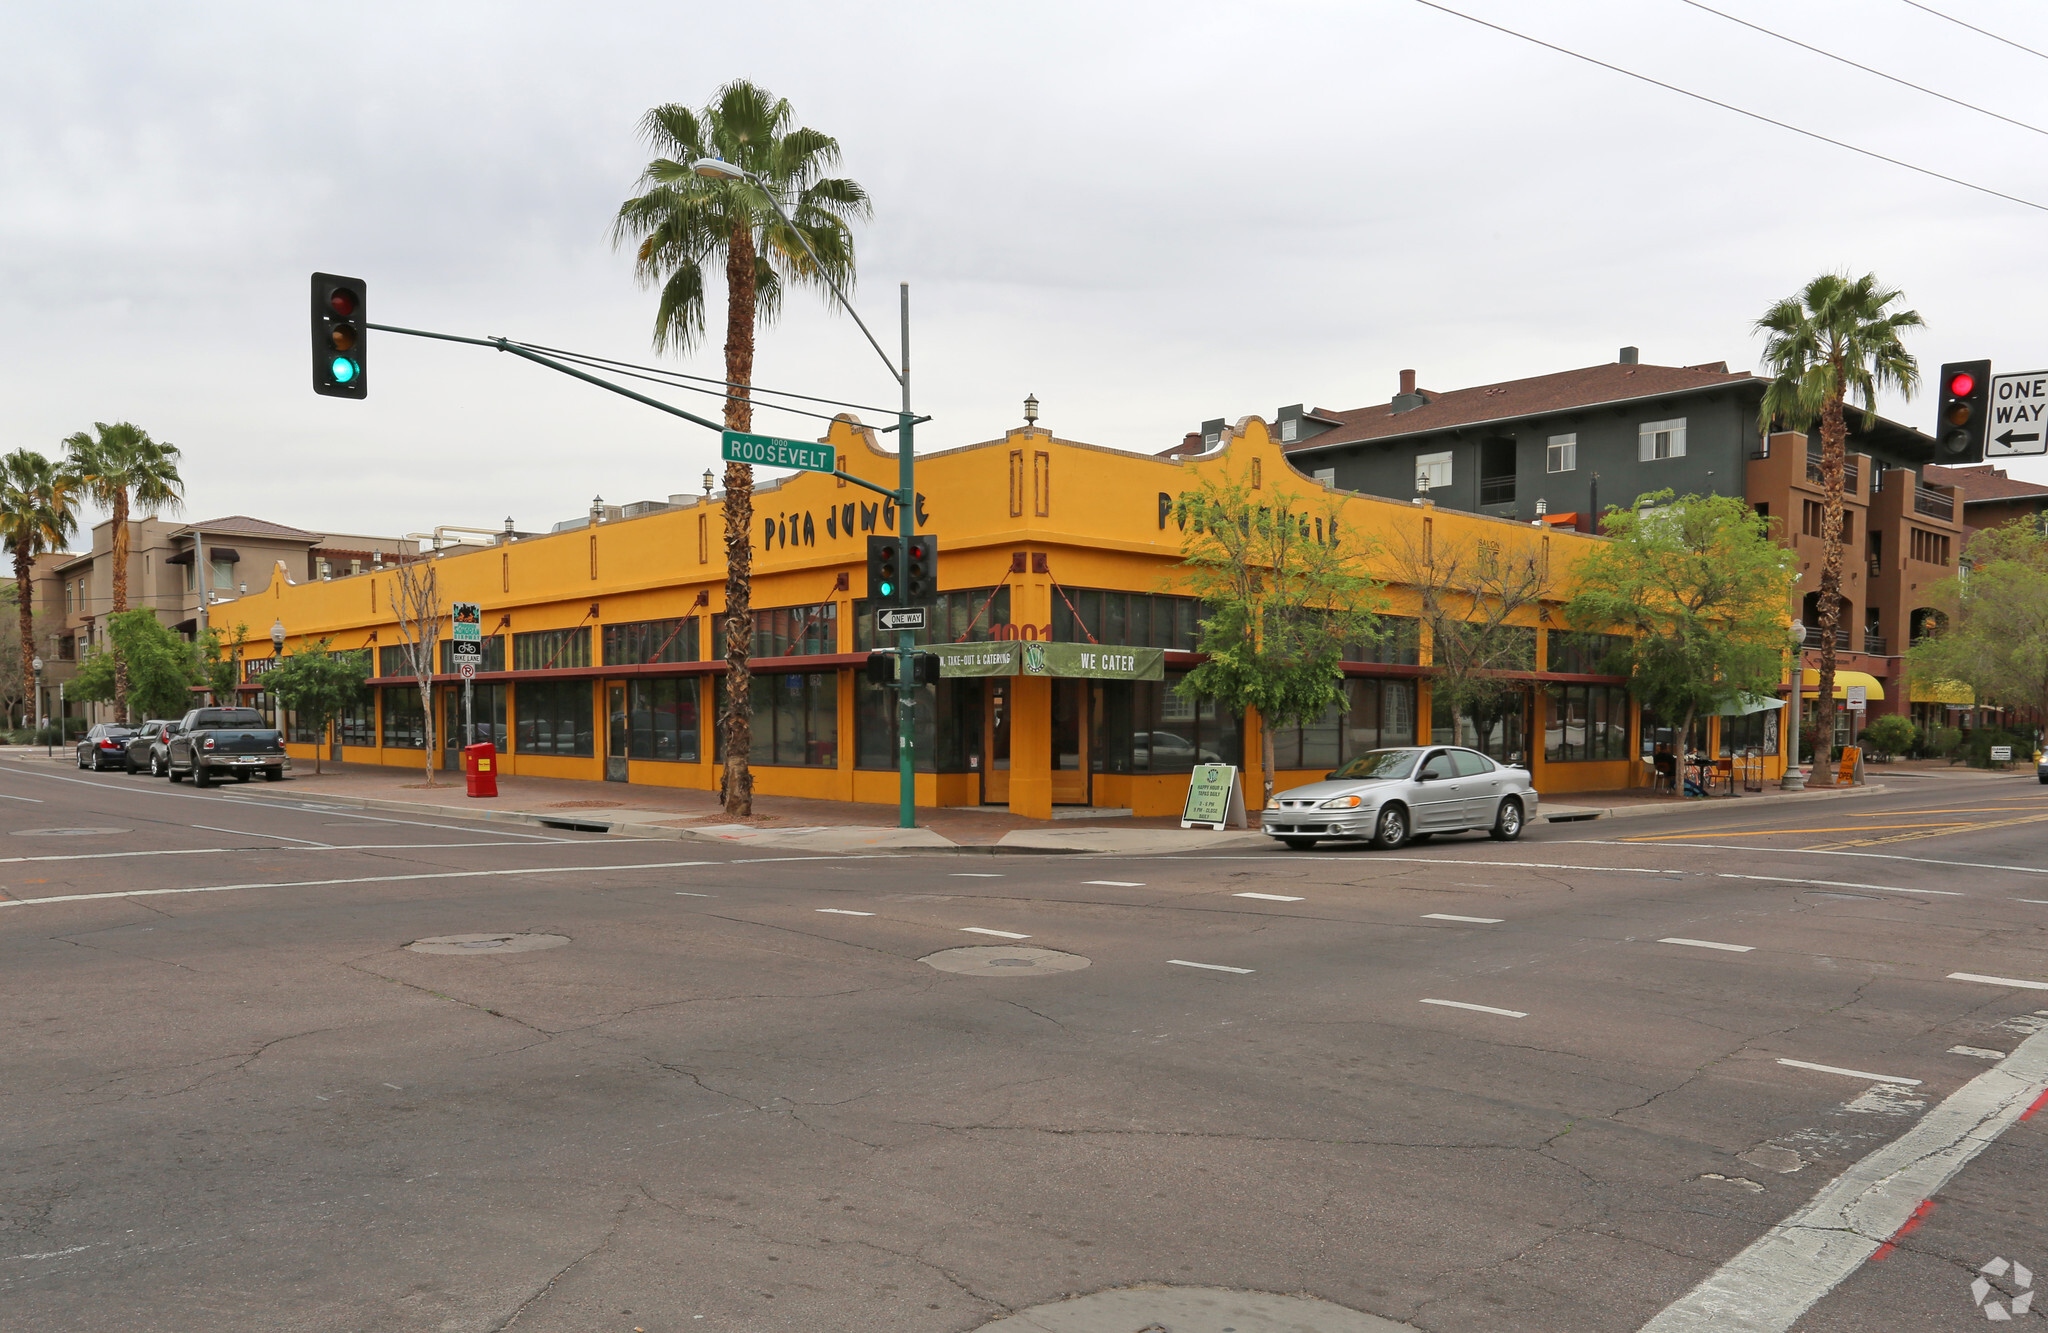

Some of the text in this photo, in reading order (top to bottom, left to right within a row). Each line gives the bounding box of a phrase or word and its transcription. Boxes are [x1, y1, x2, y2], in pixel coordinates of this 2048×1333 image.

[1998, 379, 2047, 400] ONE
[1996, 403, 2046, 424] WAY
[771, 438, 788, 447] 1000
[731, 440, 827, 468] ROOSEVELT
[826, 492, 929, 539] JUNGE
[1478, 538, 1500, 549] SALON
[891, 614, 921, 623] ONE WAY
[988, 623, 1053, 641] 1001
[454, 654, 466, 662] BIKE
[947, 654, 975, 667] TAKE-OUT
[982, 653, 1011, 665] CATERING
[1080, 653, 1134, 671] WE CATER
